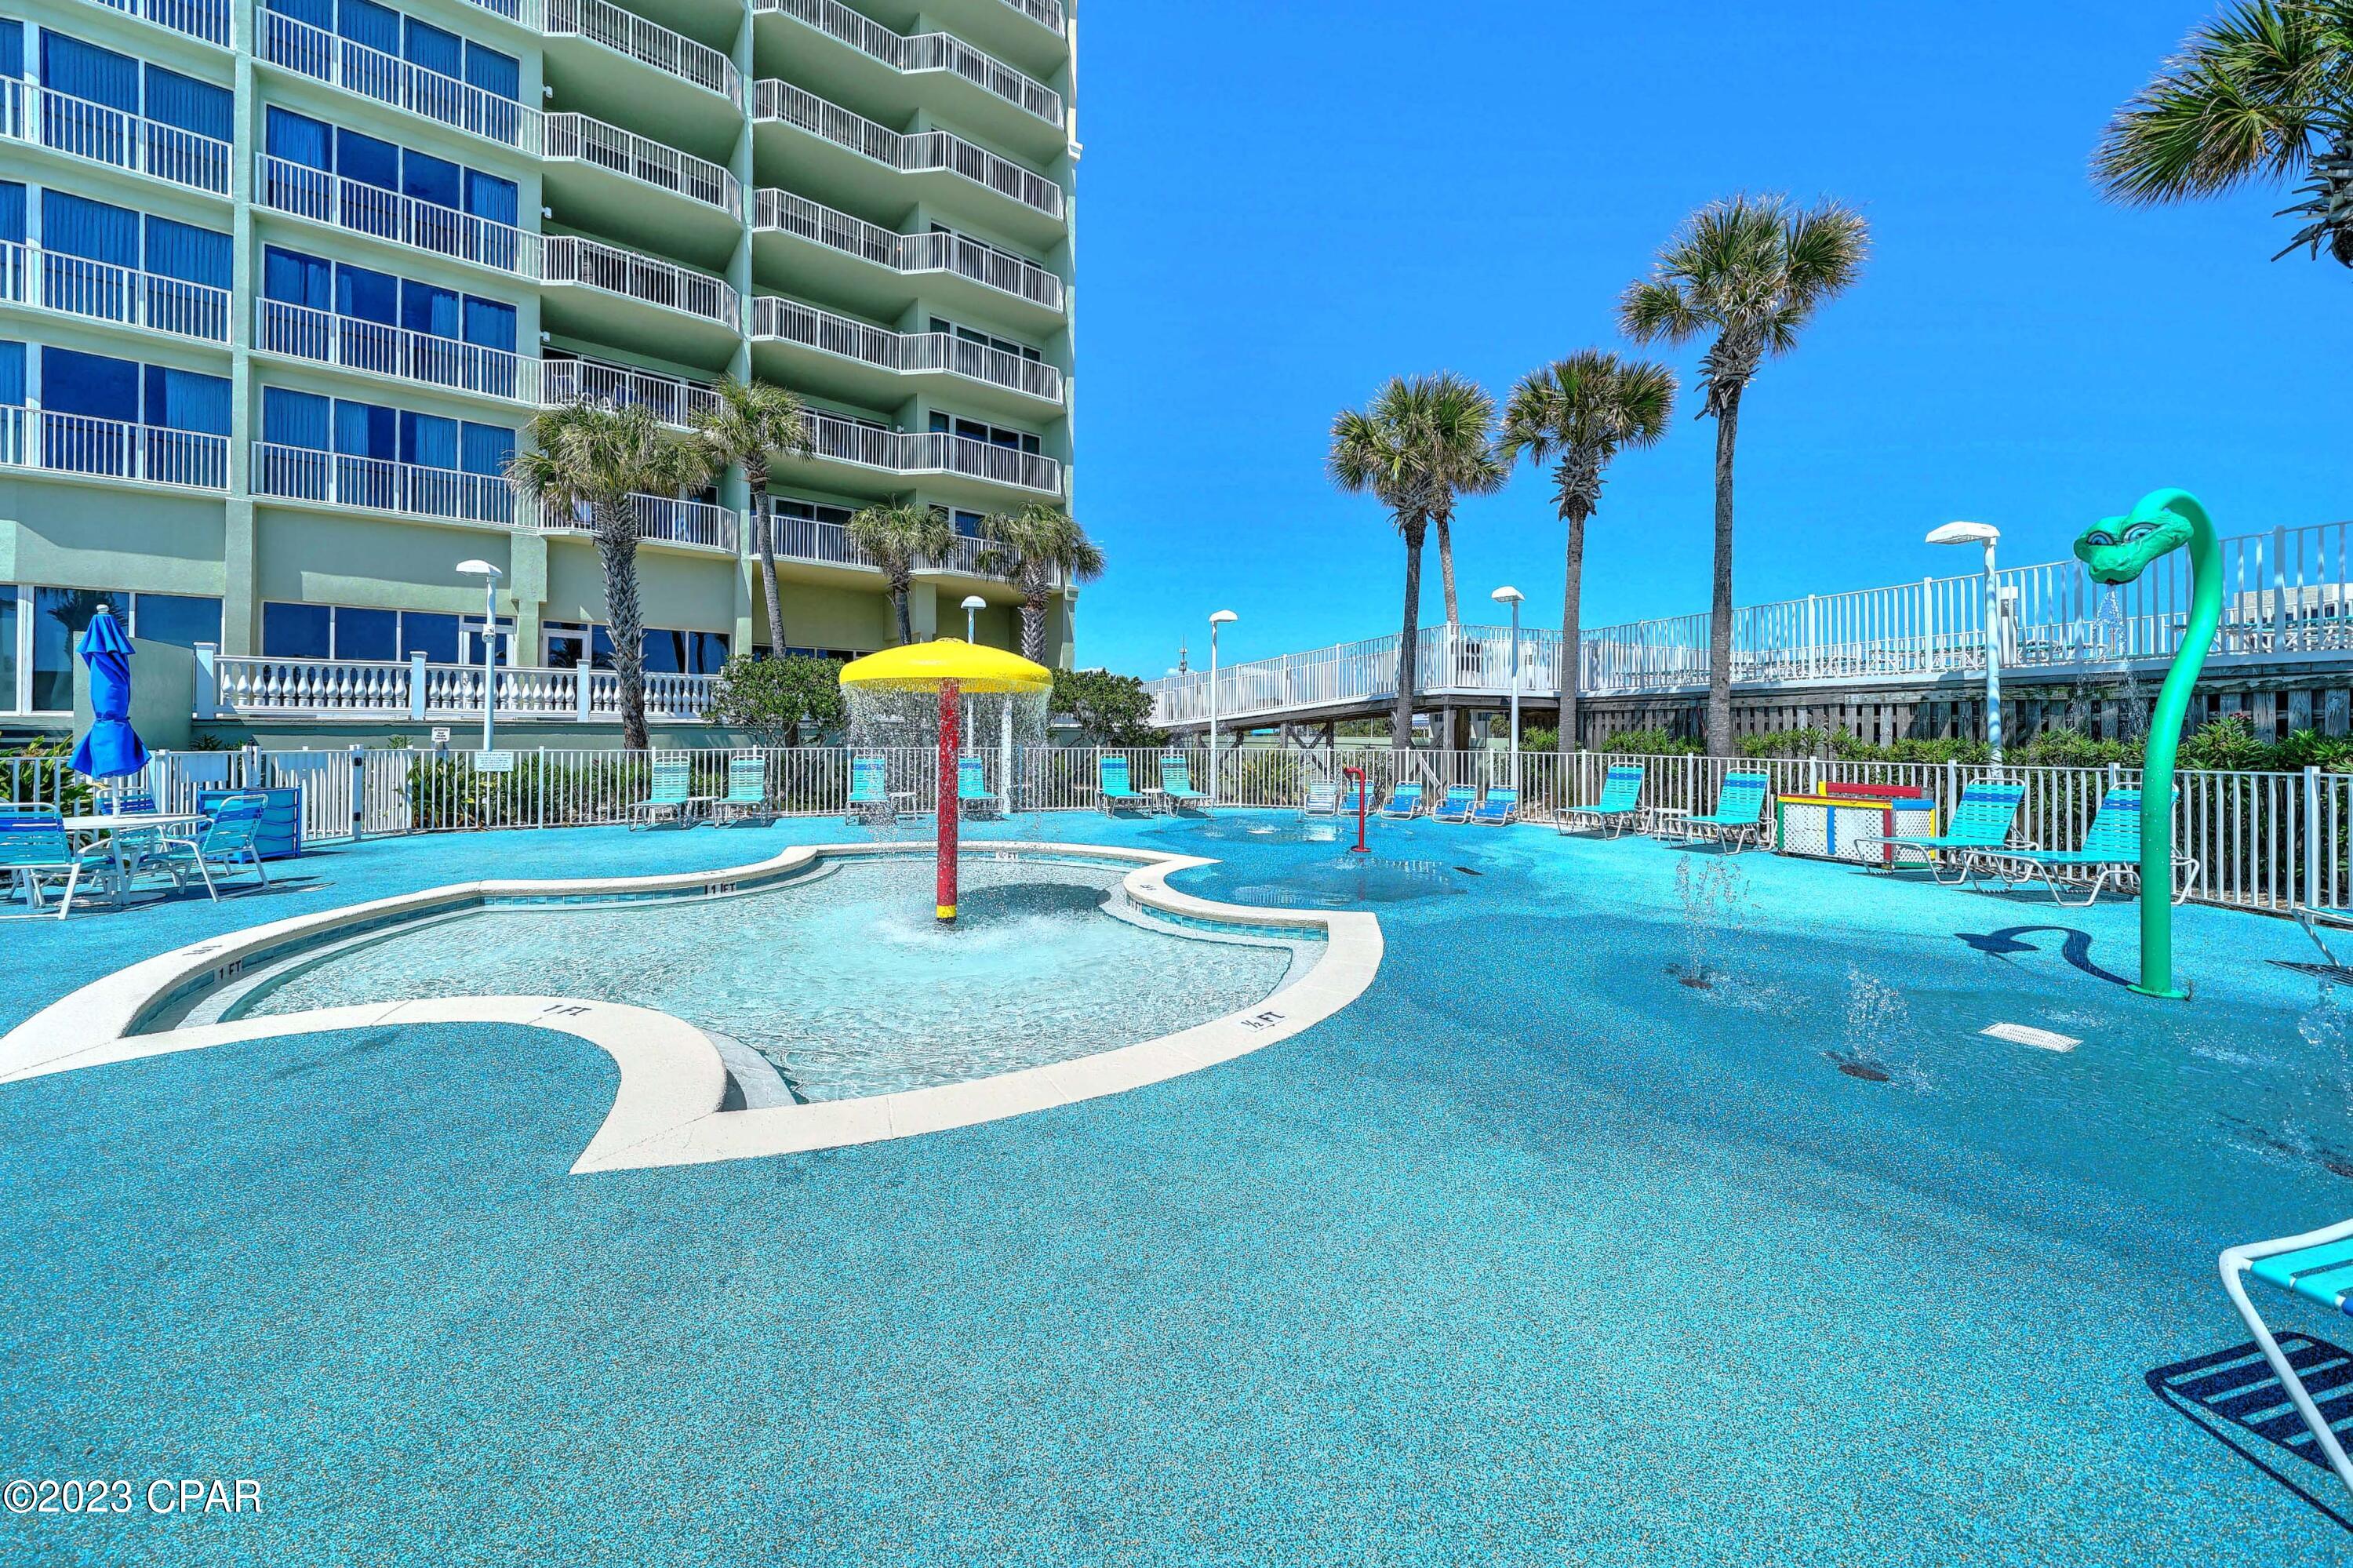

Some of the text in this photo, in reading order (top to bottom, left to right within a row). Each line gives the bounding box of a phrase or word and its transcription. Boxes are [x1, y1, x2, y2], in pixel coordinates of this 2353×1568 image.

[229, 959, 242, 975] FT
[557, 1006, 592, 1016] FT
[1256, 1012, 1286, 1022] FT
